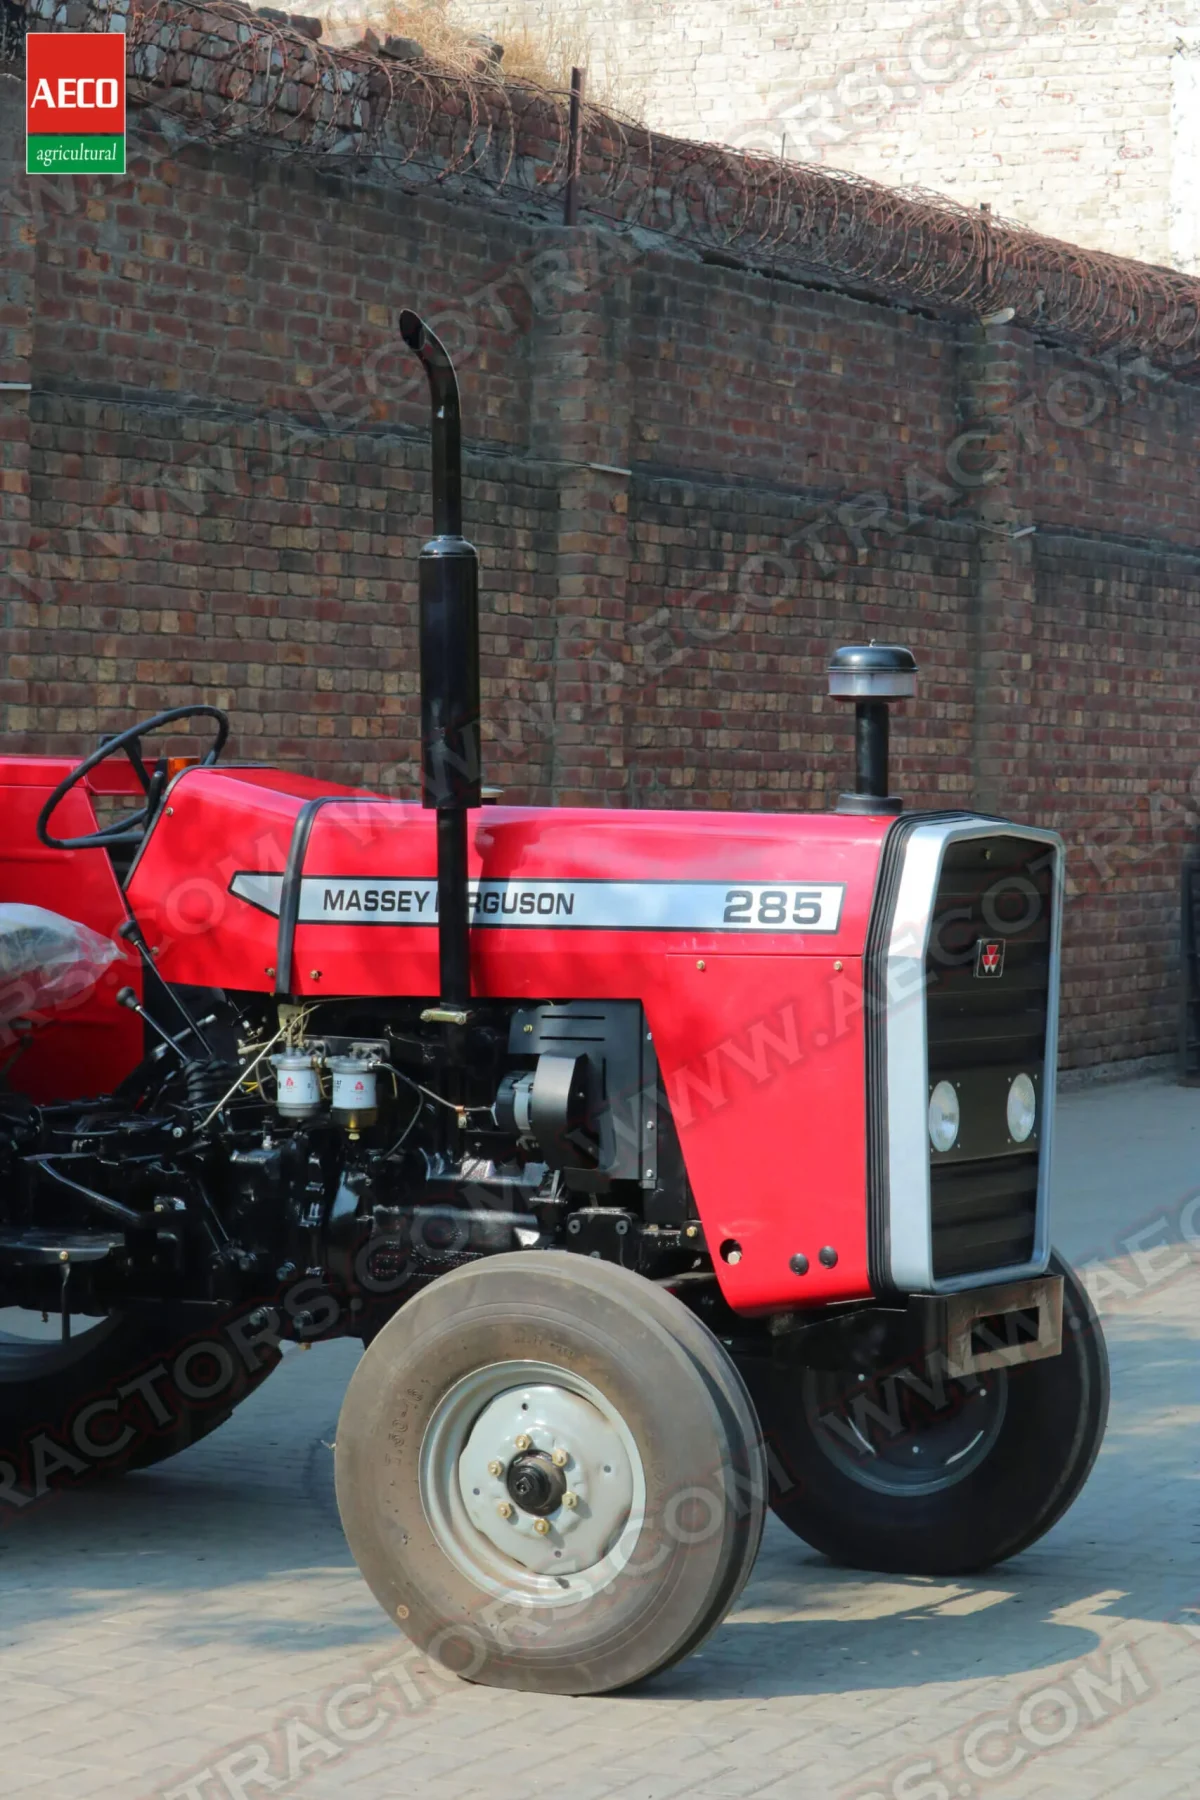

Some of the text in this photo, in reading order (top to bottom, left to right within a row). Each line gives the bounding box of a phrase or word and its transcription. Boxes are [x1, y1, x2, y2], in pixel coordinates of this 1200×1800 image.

[323, 889, 575, 915] MASSEY RGUSON
[723, 890, 822, 925] 285
